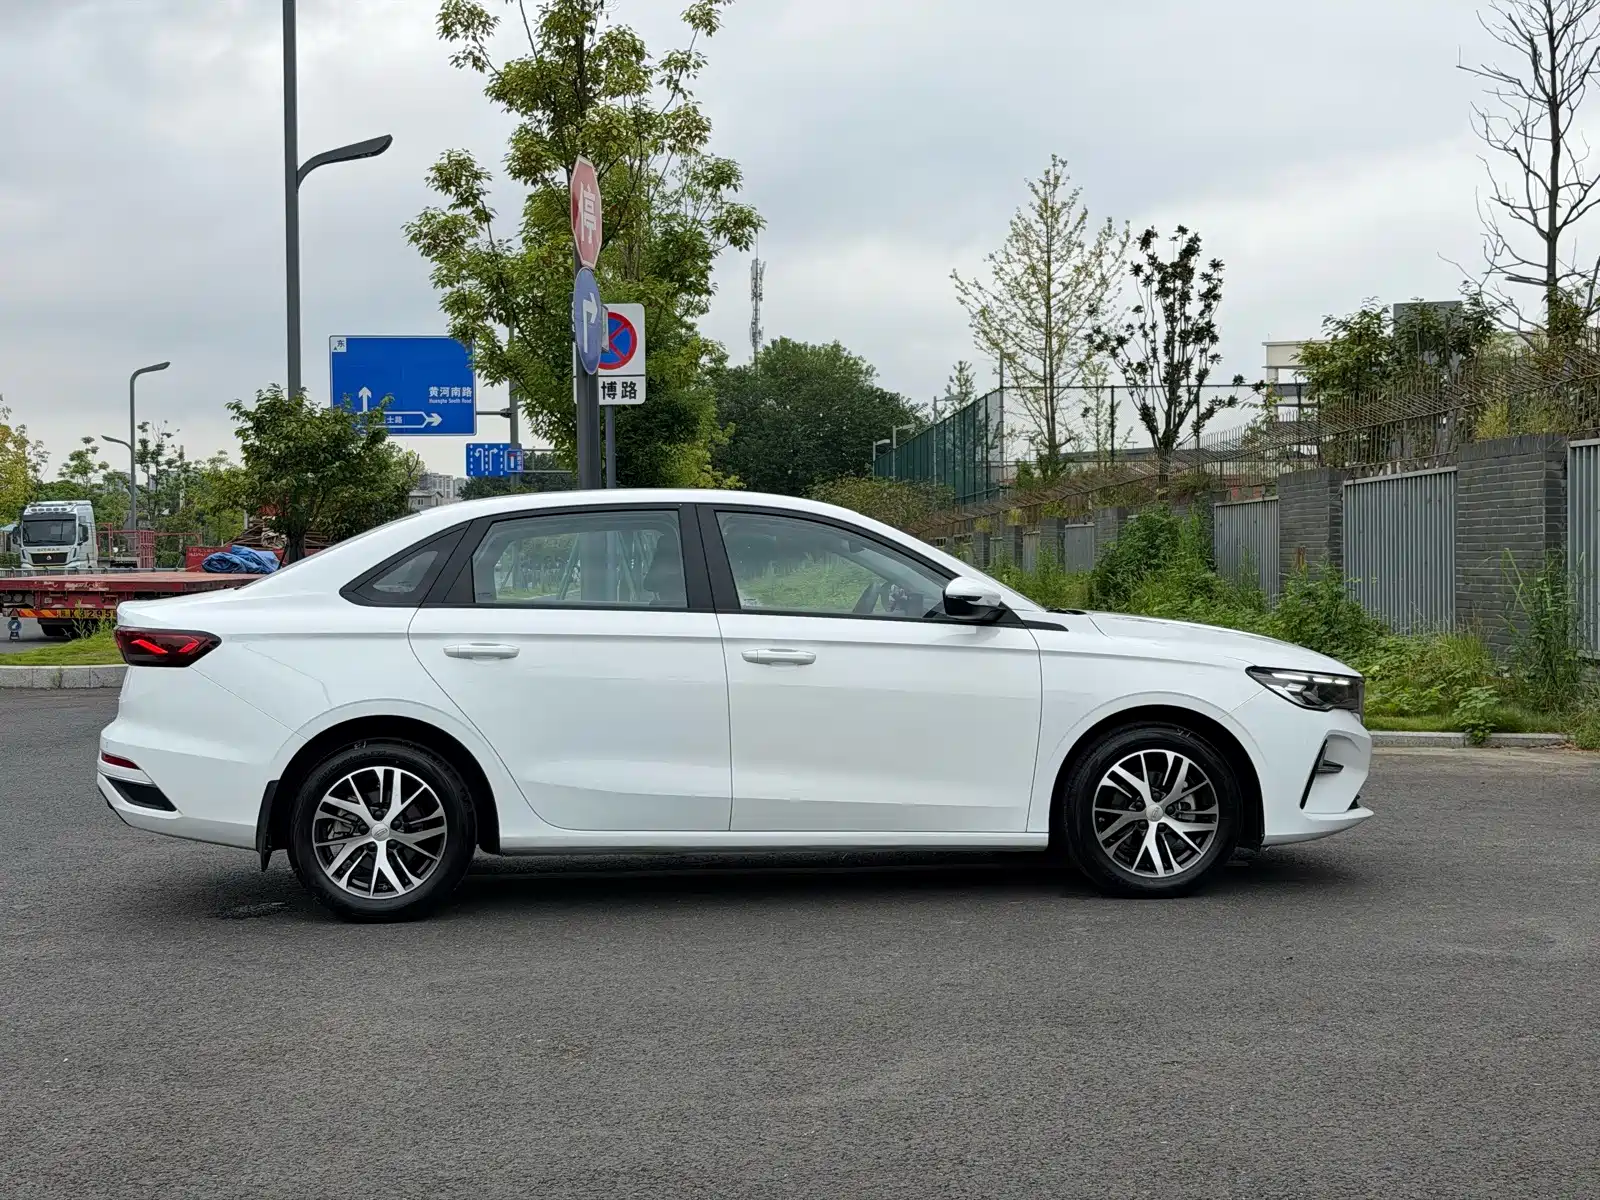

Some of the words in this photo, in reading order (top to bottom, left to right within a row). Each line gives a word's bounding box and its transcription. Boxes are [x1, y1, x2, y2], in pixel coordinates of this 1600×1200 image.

[578, 181, 597, 245] 停
[336, 339, 345, 348] 东
[428, 386, 472, 398] 黄河南路
[600, 380, 638, 401] 博路
